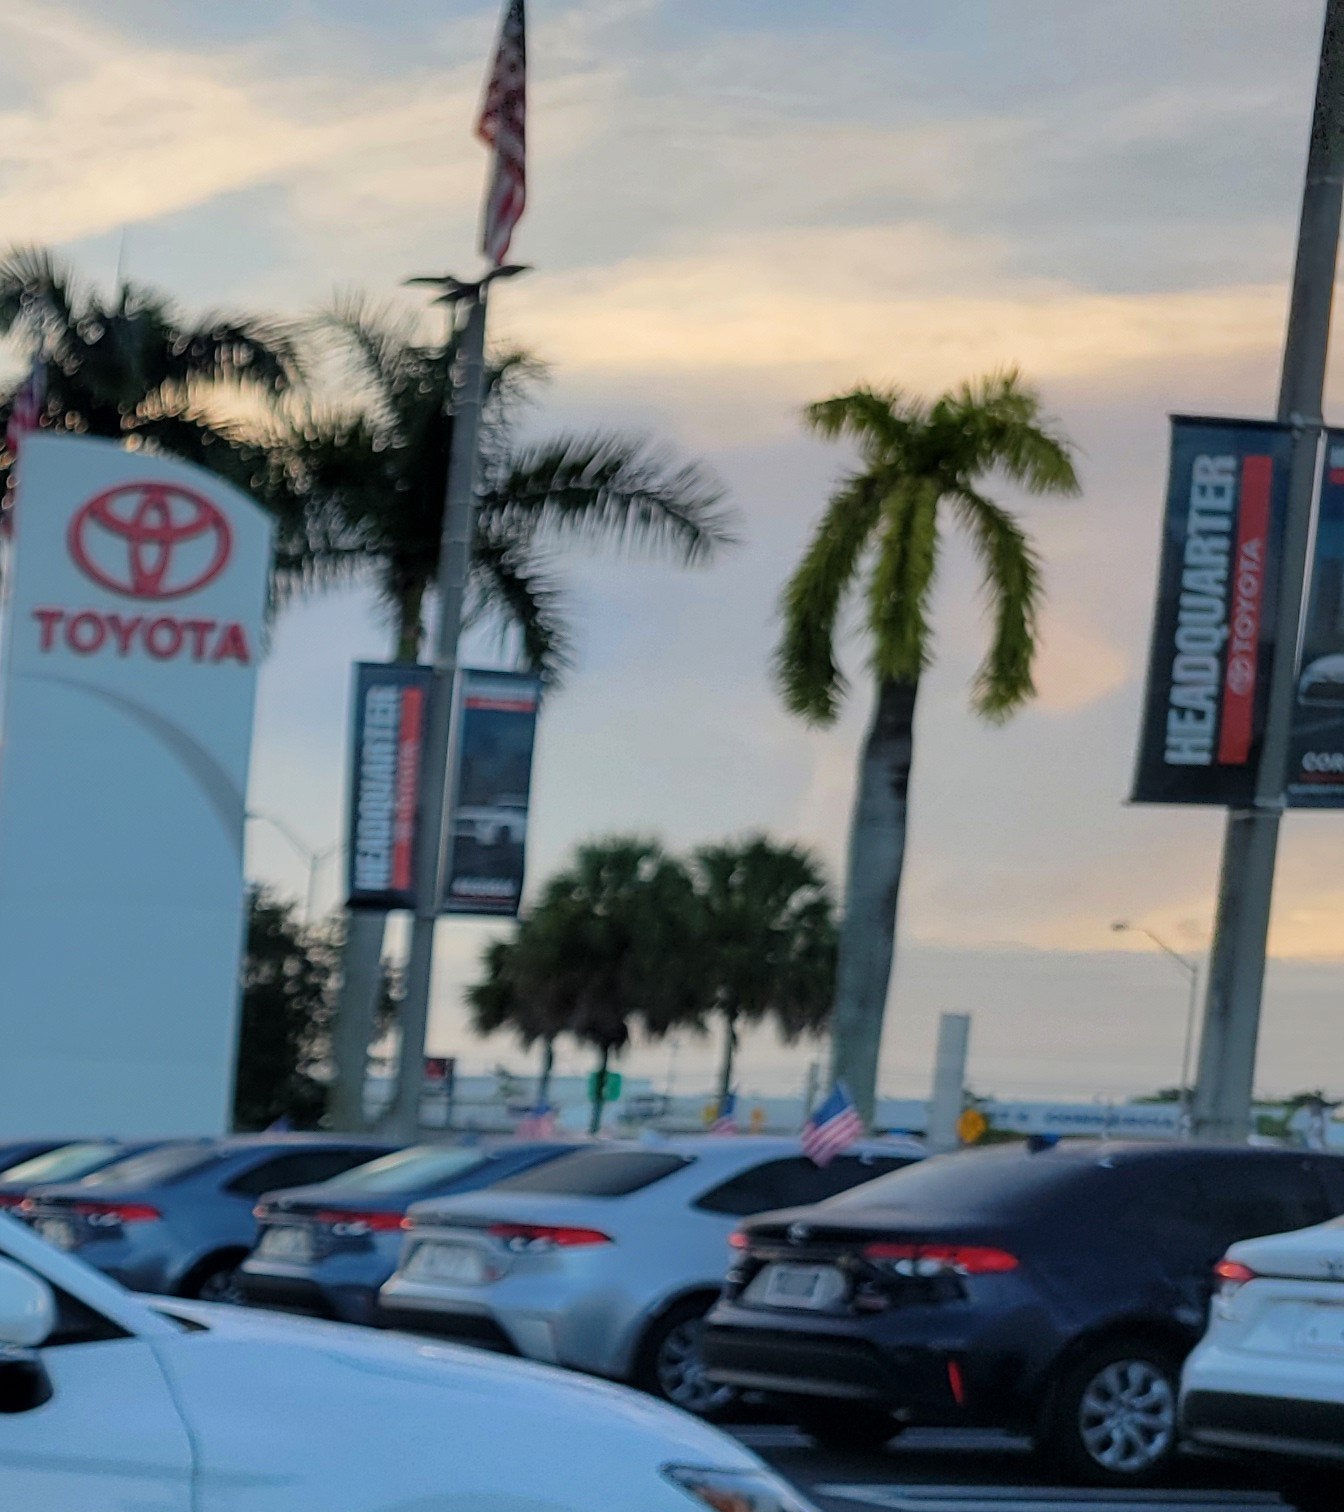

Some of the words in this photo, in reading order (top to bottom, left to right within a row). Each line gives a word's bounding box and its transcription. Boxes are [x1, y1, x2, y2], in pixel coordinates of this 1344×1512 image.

[32, 607, 251, 664] TOYOTA
[1164, 454, 1237, 766] HEADQUARTER
[1232, 537, 1263, 653] TOYOTA
